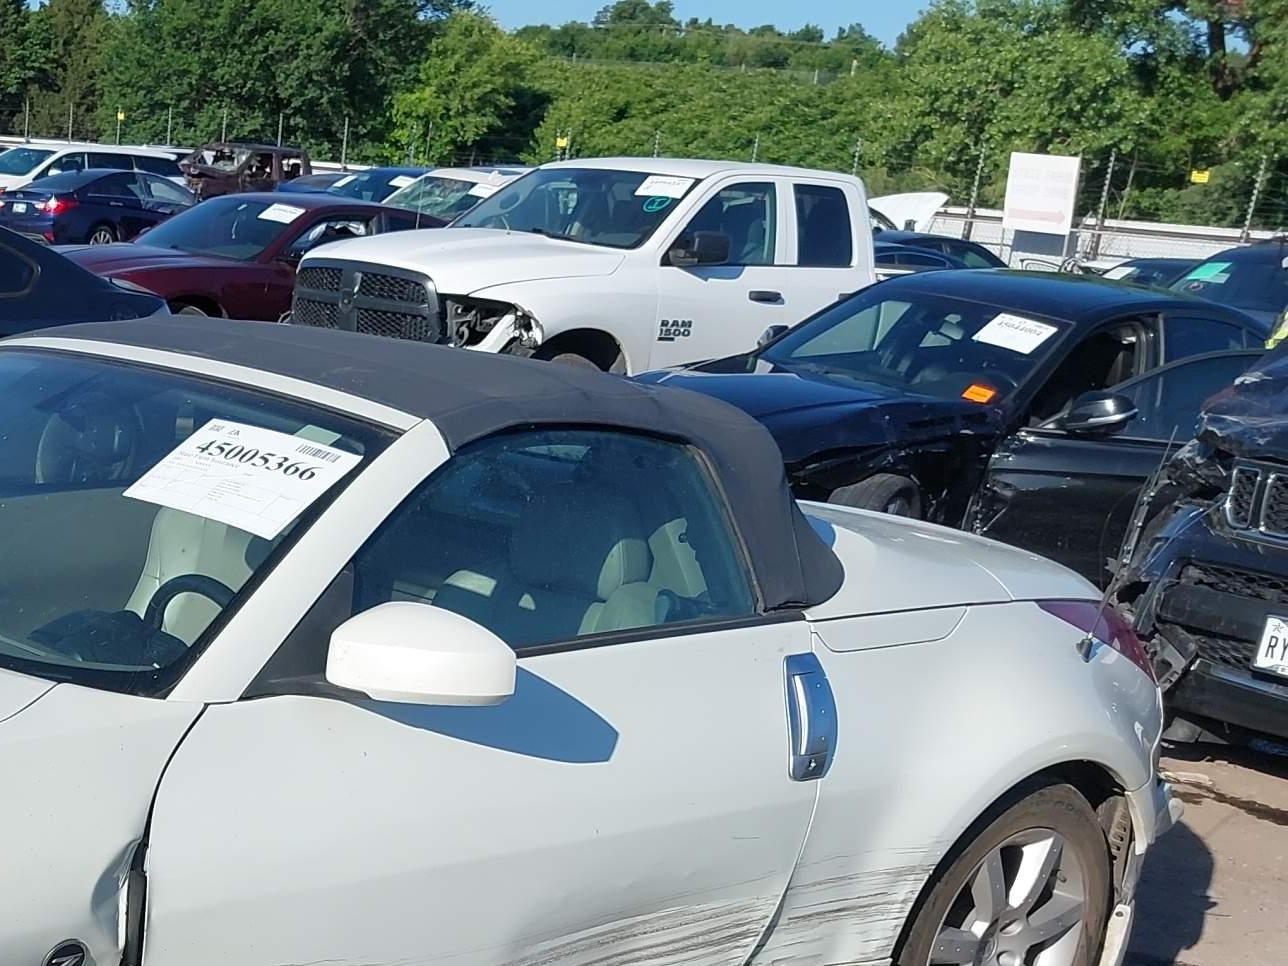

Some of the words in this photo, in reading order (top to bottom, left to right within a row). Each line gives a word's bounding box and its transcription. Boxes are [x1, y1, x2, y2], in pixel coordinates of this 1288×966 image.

[660, 319, 693, 329] RAM
[658, 327, 691, 337] 1500
[196, 440, 325, 481] 45005366
